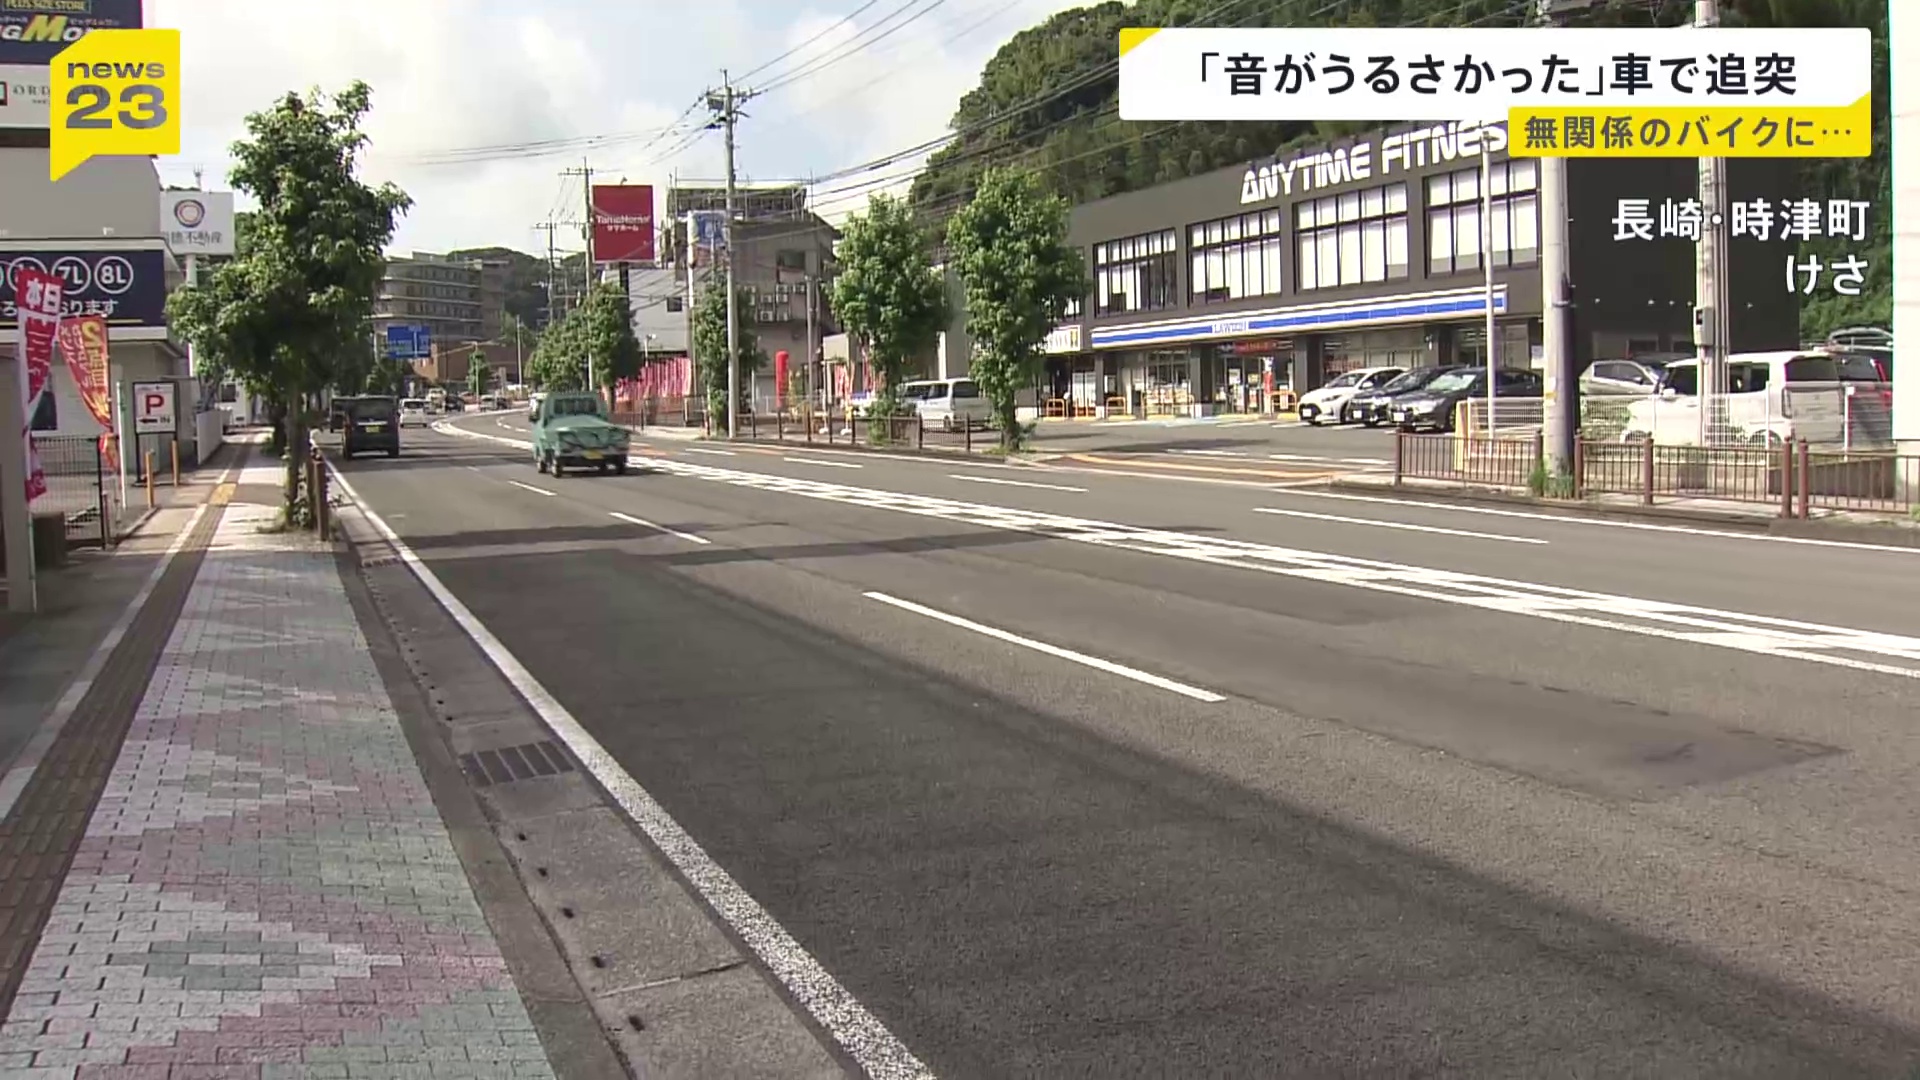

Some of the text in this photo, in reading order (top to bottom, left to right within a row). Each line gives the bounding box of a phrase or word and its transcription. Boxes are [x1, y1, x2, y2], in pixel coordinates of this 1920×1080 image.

[1241, 141, 1371, 204] ANYTIME
[101, 264, 127, 285] 8L
[145, 394, 165, 415] P
